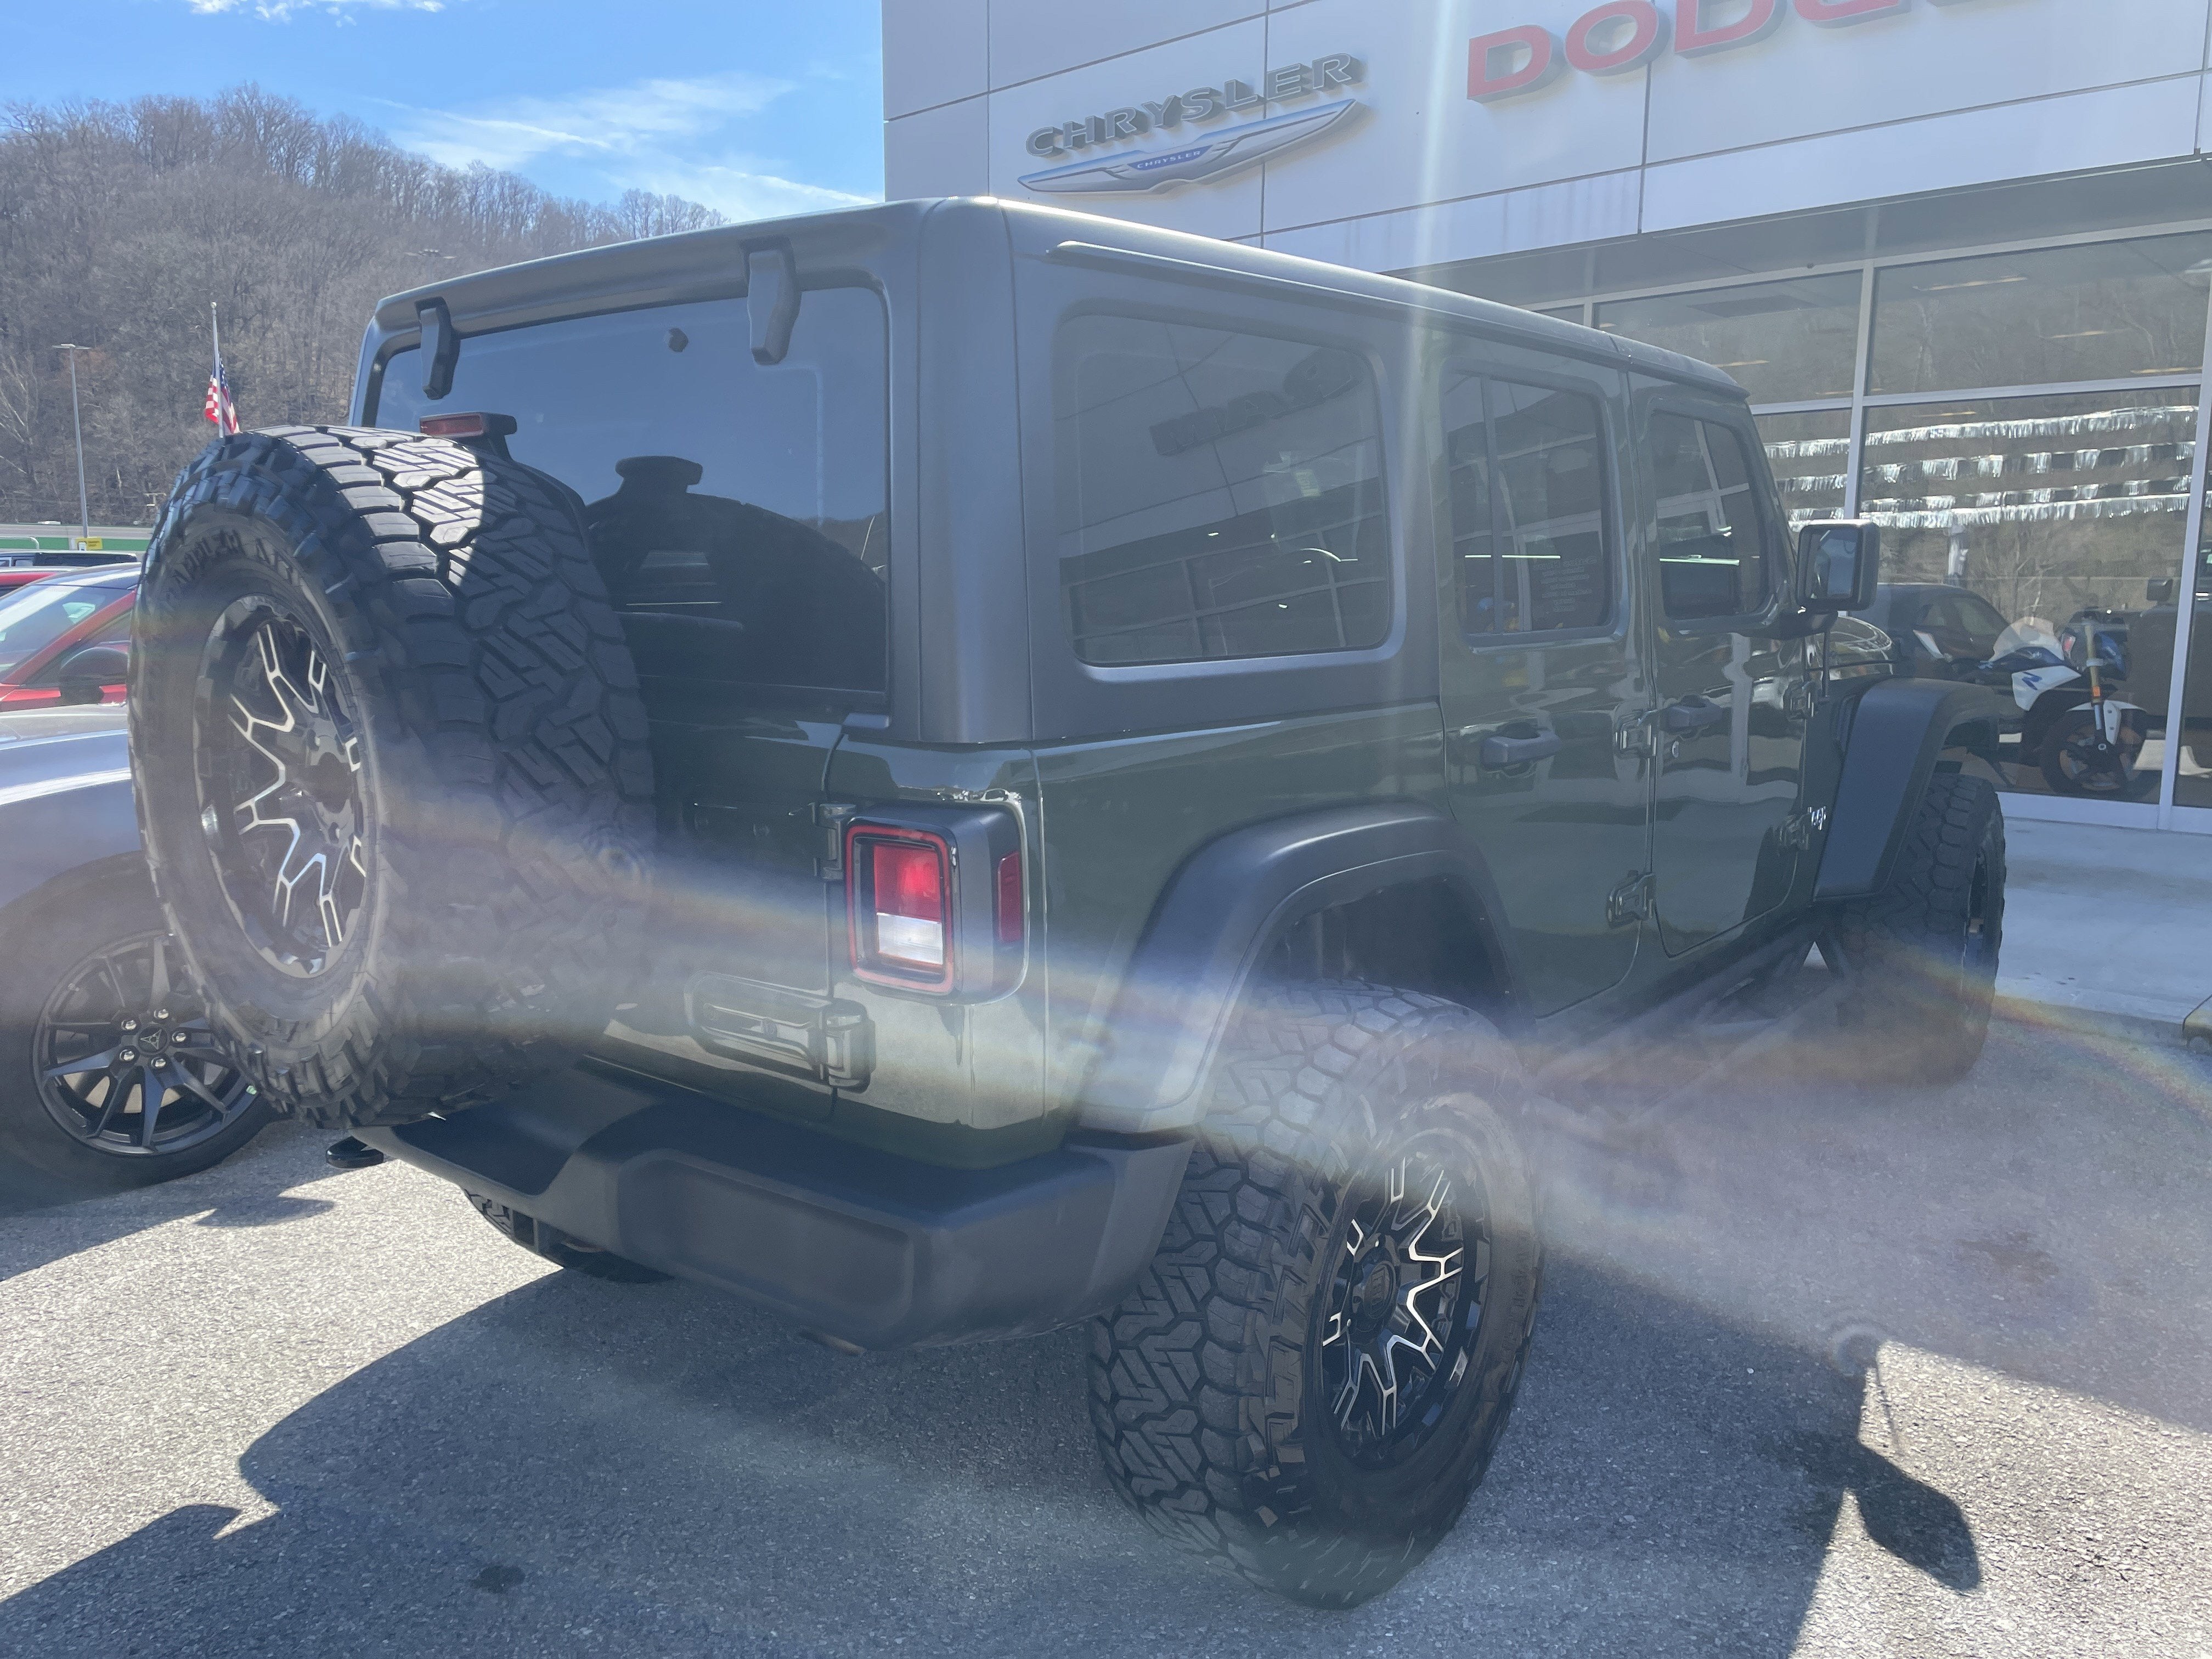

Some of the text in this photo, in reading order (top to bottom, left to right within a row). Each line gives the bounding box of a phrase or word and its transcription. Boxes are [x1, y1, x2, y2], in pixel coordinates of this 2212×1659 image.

[1467, 0, 1908, 102] DOD
[1025, 53, 1362, 157] CHRYSLER
[1137, 150, 1200, 168] CHRYSLER
